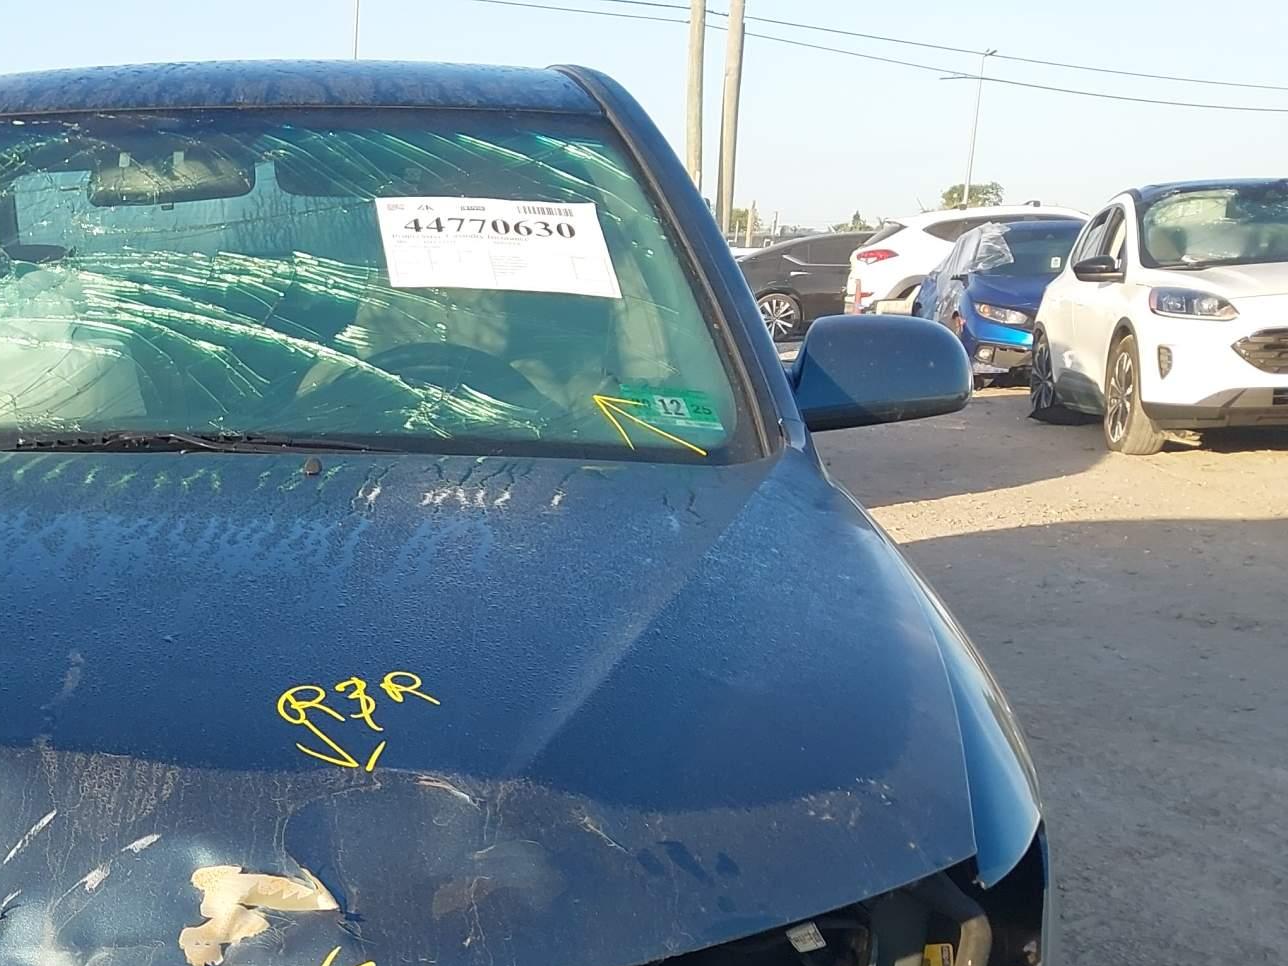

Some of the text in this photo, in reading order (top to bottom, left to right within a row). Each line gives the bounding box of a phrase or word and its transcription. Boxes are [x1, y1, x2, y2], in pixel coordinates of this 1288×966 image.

[403, 216, 577, 239] 44770630
[658, 398, 685, 416] 12
[691, 403, 713, 416] 25
